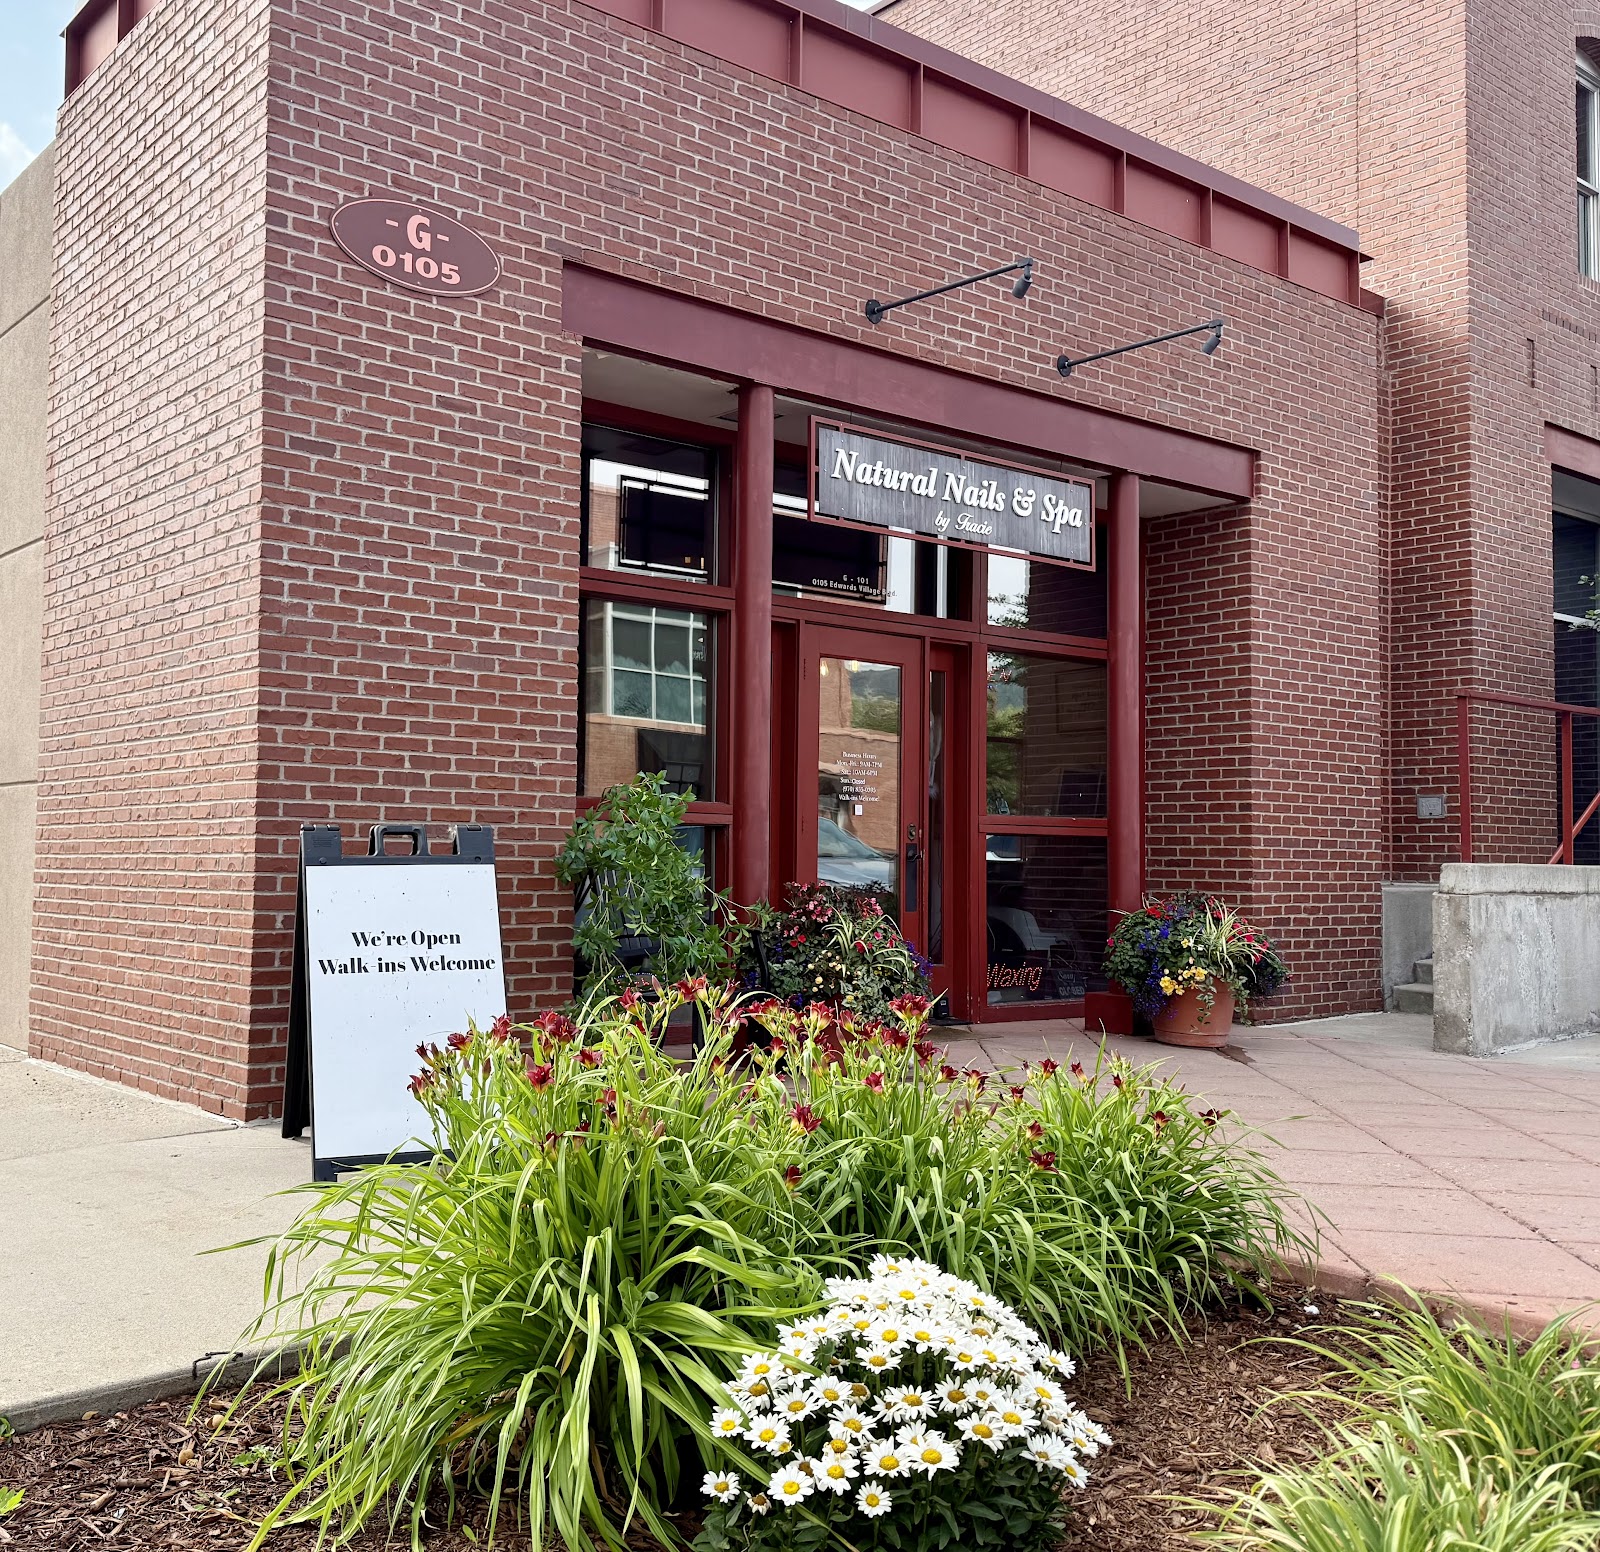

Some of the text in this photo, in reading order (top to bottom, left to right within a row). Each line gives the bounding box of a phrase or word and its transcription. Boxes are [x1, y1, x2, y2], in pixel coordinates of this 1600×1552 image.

[372, 244, 461, 285] 0105
[831, 448, 1083, 533] Natural Nails & Spa
[934, 510, 993, 535] by Tracie
[812, 578, 828, 586] 0105
[830, 580, 858, 591] Edwards
[858, 584, 880, 596] Village
[857, 576, 869, 585] 101
[351, 930, 461, 949] We're Open
[318, 955, 496, 975] Walk-ins Welcome
[986, 961, 1043, 991] Waxing
